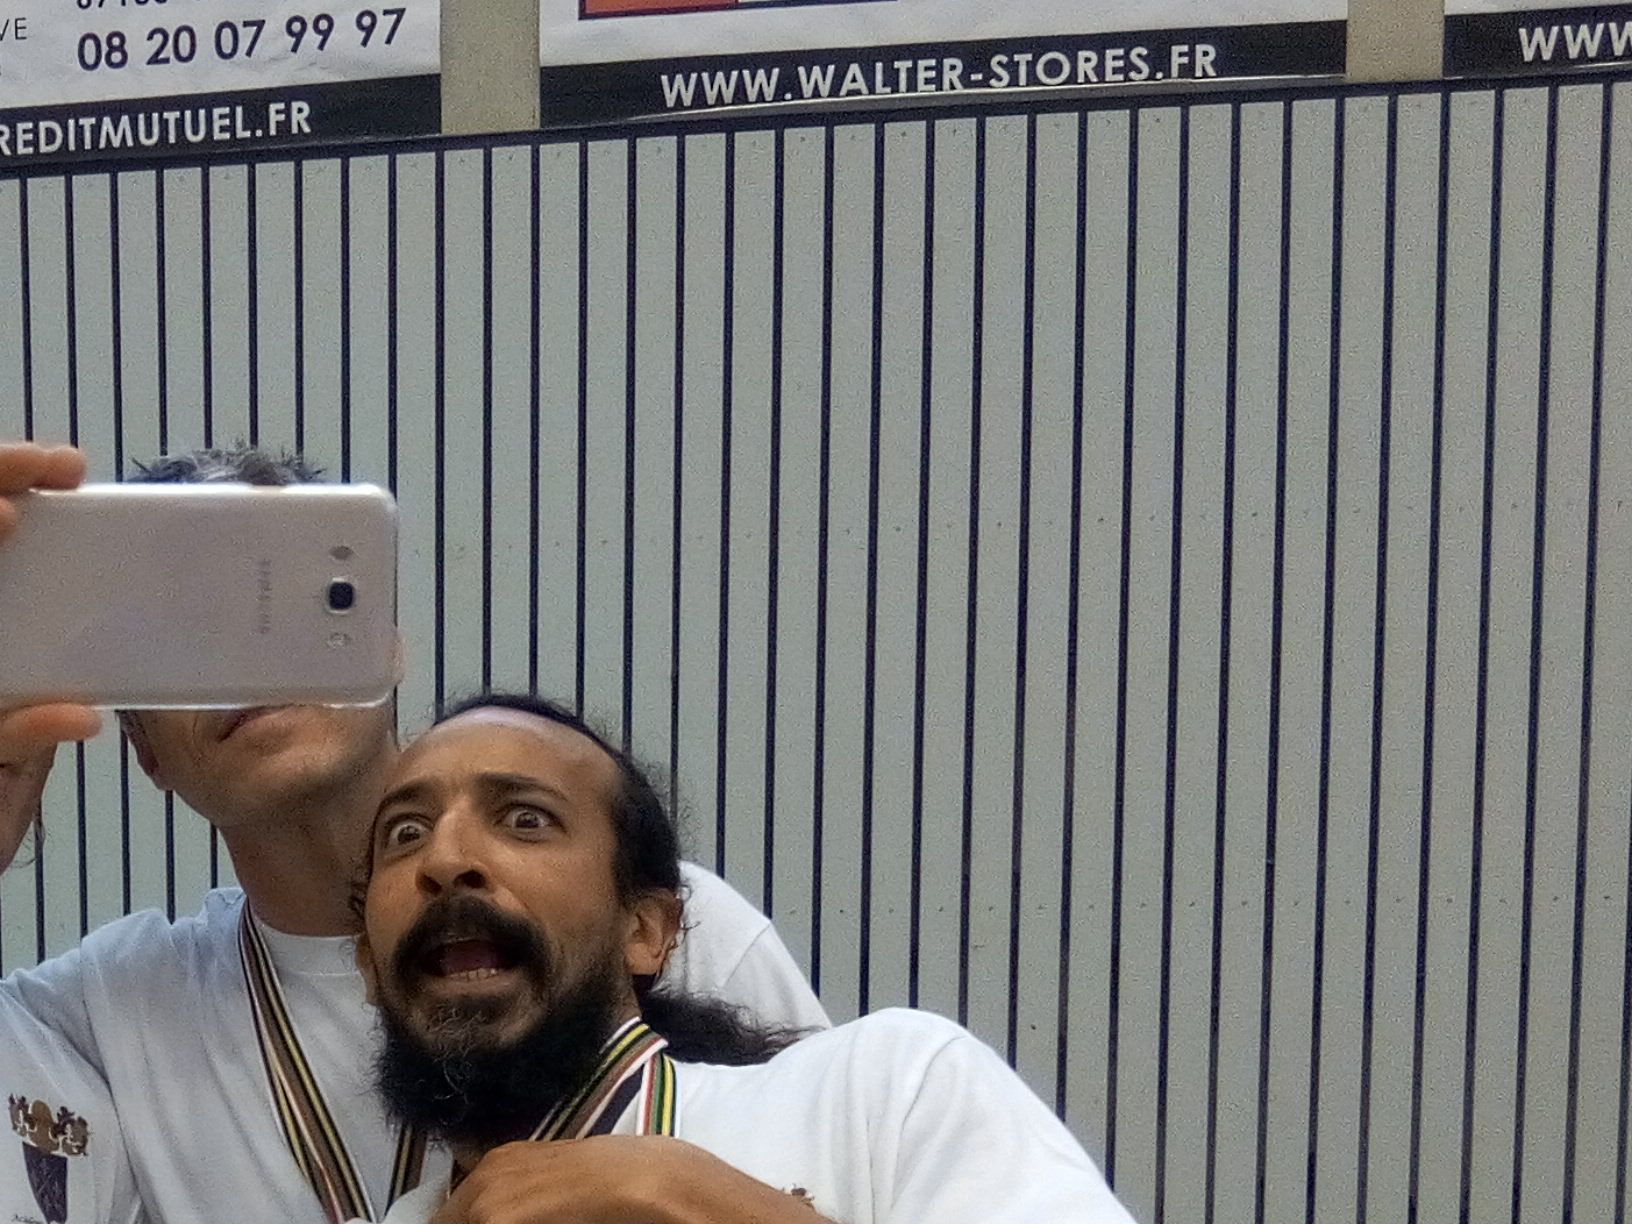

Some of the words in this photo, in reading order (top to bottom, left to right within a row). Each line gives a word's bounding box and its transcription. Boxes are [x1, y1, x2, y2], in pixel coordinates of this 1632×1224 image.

[77, 31, 128, 71] 08
[146, 25, 198, 66] 20
[214, 19, 266, 61] 07
[285, 13, 335, 53] 99
[355, 7, 407, 48] 97
[660, 43, 1218, 108] WWW.WALTER-STORES.FR
